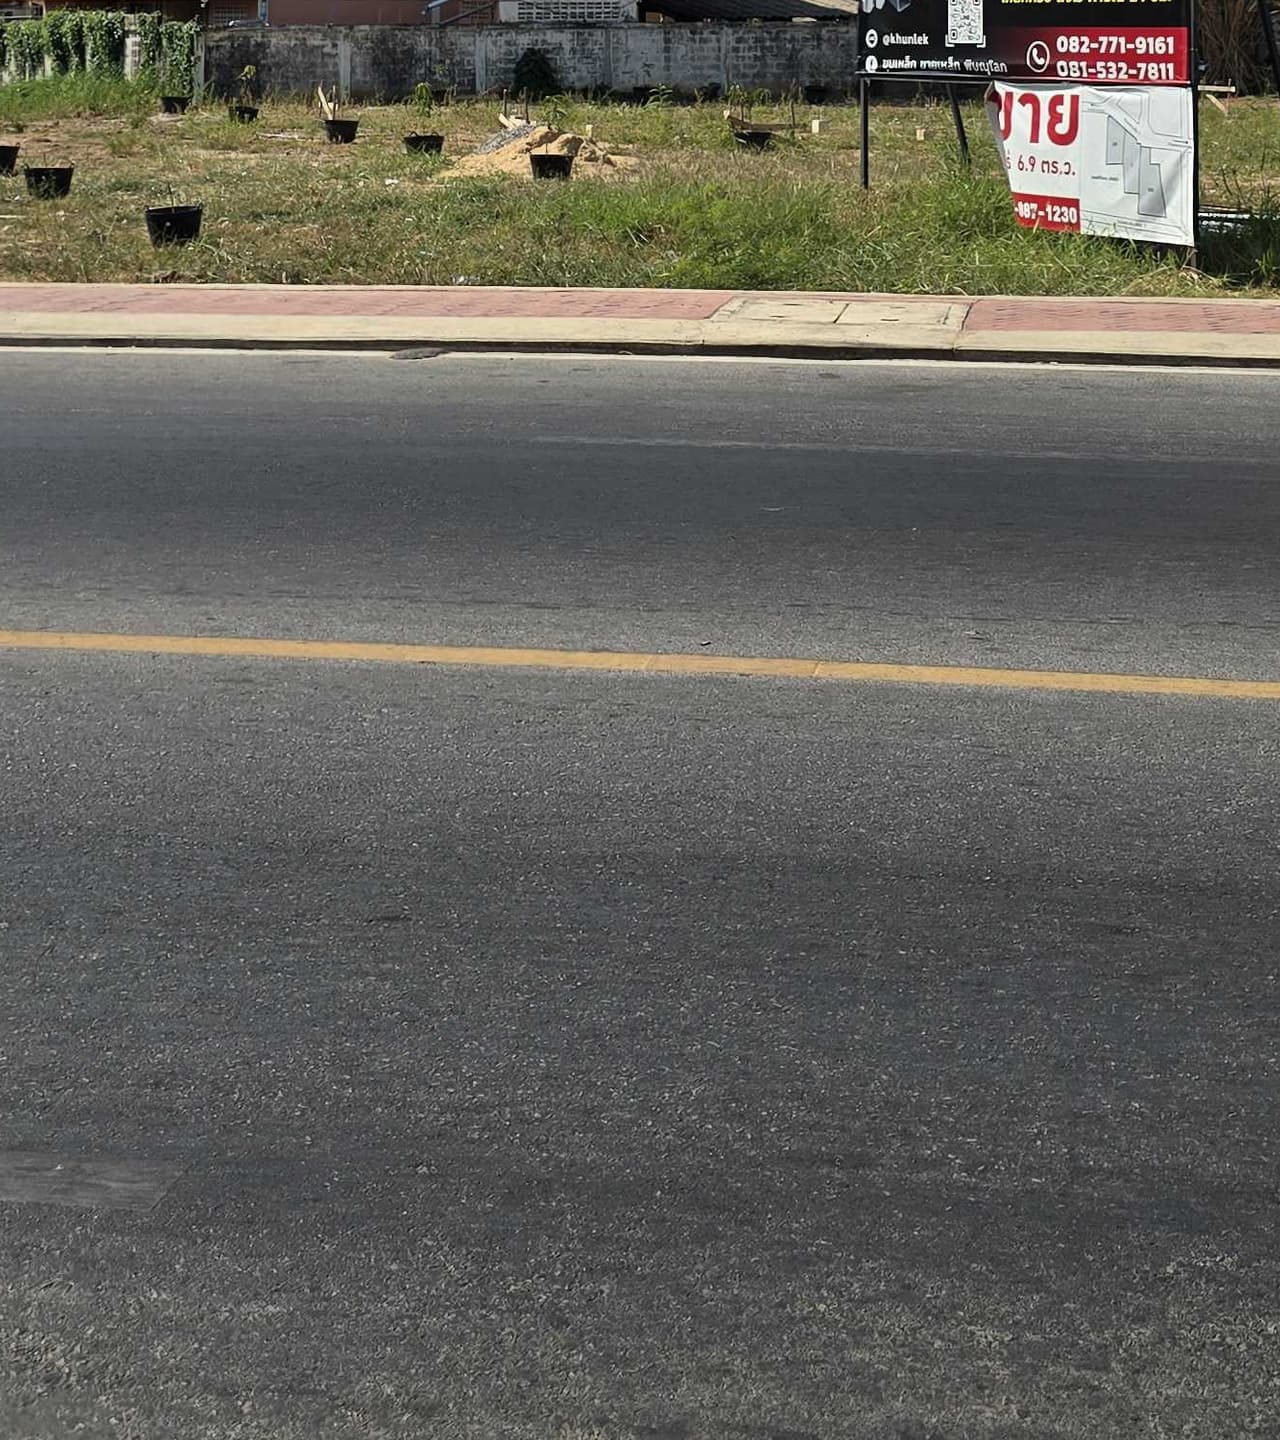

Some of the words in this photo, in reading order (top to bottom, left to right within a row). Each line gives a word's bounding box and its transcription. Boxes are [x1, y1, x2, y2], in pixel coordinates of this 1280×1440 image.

[882, 32, 929, 46] @khunlek
[1056, 35, 1175, 55] 082-771-9161
[1056, 60, 1175, 80] 081-532-7811
[1017, 154, 1036, 172] 6.9
